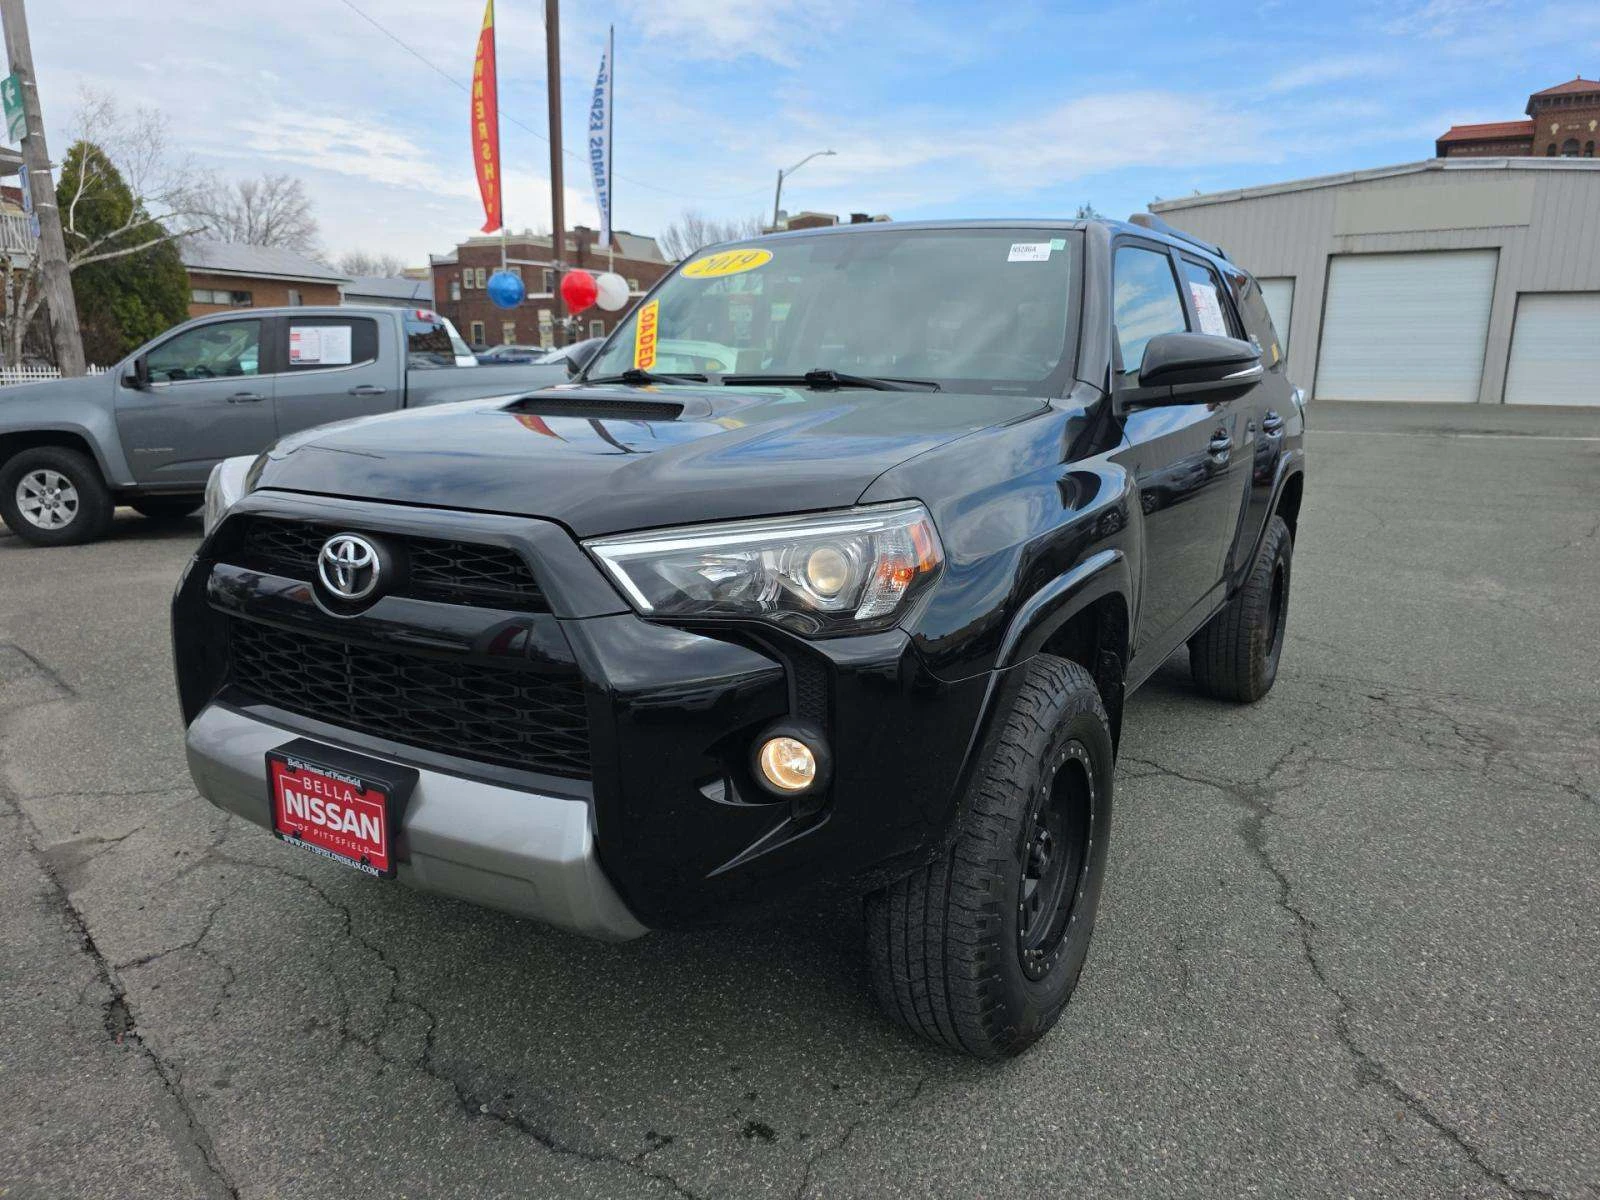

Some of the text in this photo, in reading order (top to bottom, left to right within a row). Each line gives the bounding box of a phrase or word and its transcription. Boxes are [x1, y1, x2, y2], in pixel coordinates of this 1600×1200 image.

[638, 303, 656, 369] LOADED
[303, 777, 353, 803] BELLA
[285, 789, 381, 844] NISSAN
[297, 824, 369, 854] OF PITTSFIELD
